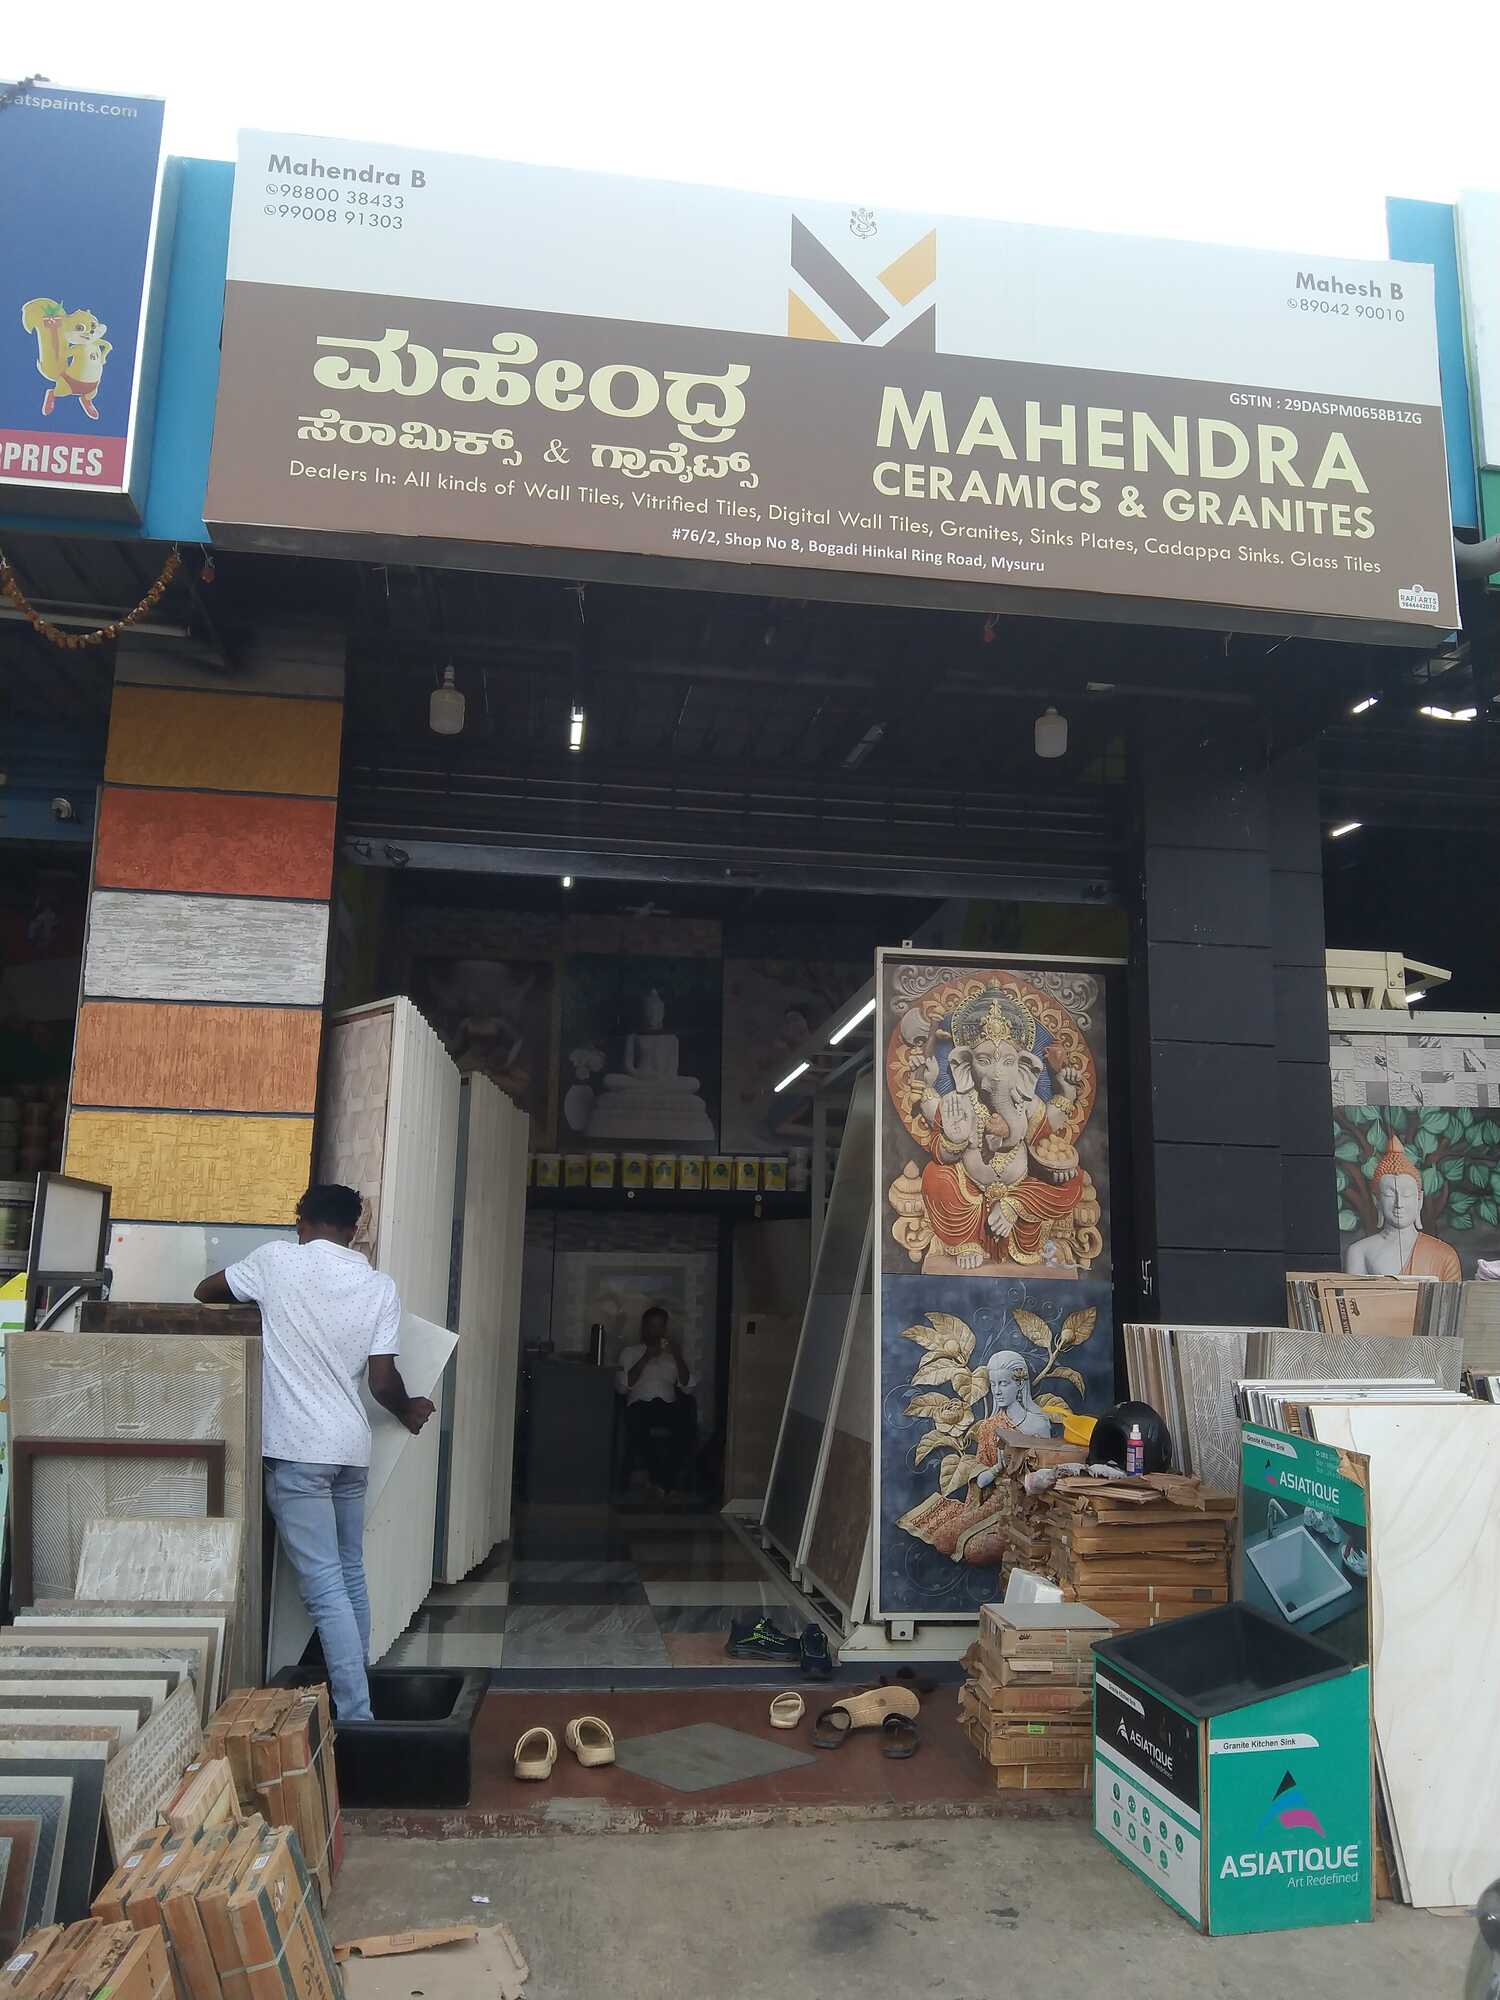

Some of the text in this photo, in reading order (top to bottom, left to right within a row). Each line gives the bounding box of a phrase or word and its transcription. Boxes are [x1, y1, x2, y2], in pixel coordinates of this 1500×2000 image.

[268, 154, 426, 188] Mahendra B
[280, 184, 404, 209] 98800 38433
[279, 205, 403, 230] 99008 91303
[1296, 271, 1404, 300] Mahesh B
[1300, 299, 1405, 322] 89042 90010
[313, 328, 751, 443] ಮಹೇಂದ್ರ
[1229, 393, 1272, 409] GSTIN
[543, 439, 570, 464] &
[876, 386, 1370, 494] MAHENDRA
[0, 441, 104, 476] PRISES
[289, 460, 1382, 573] Dealers In: All kinds of Wall Tiles, Vitrified Tiles, Digital Wall Tiles, Granites, Sinks Plates, Cadappa Sinks. Glass Tiles
[873, 461, 1375, 539] CERAMICS & GRANITES
[672, 527, 1045, 575] #76/2, Shop No 8, Bogadi Hinkal Ring Road, Mysuru
[1280, 1471, 1340, 1505] ASIATIQUE
[1129, 1729, 1173, 1772] ASIATIQUE
[1223, 1737, 1296, 1751] Granite Kitchen Sink
[1220, 1844, 1360, 1880] ASIATIQUE
[1287, 1871, 1359, 1888] Art Redefined
